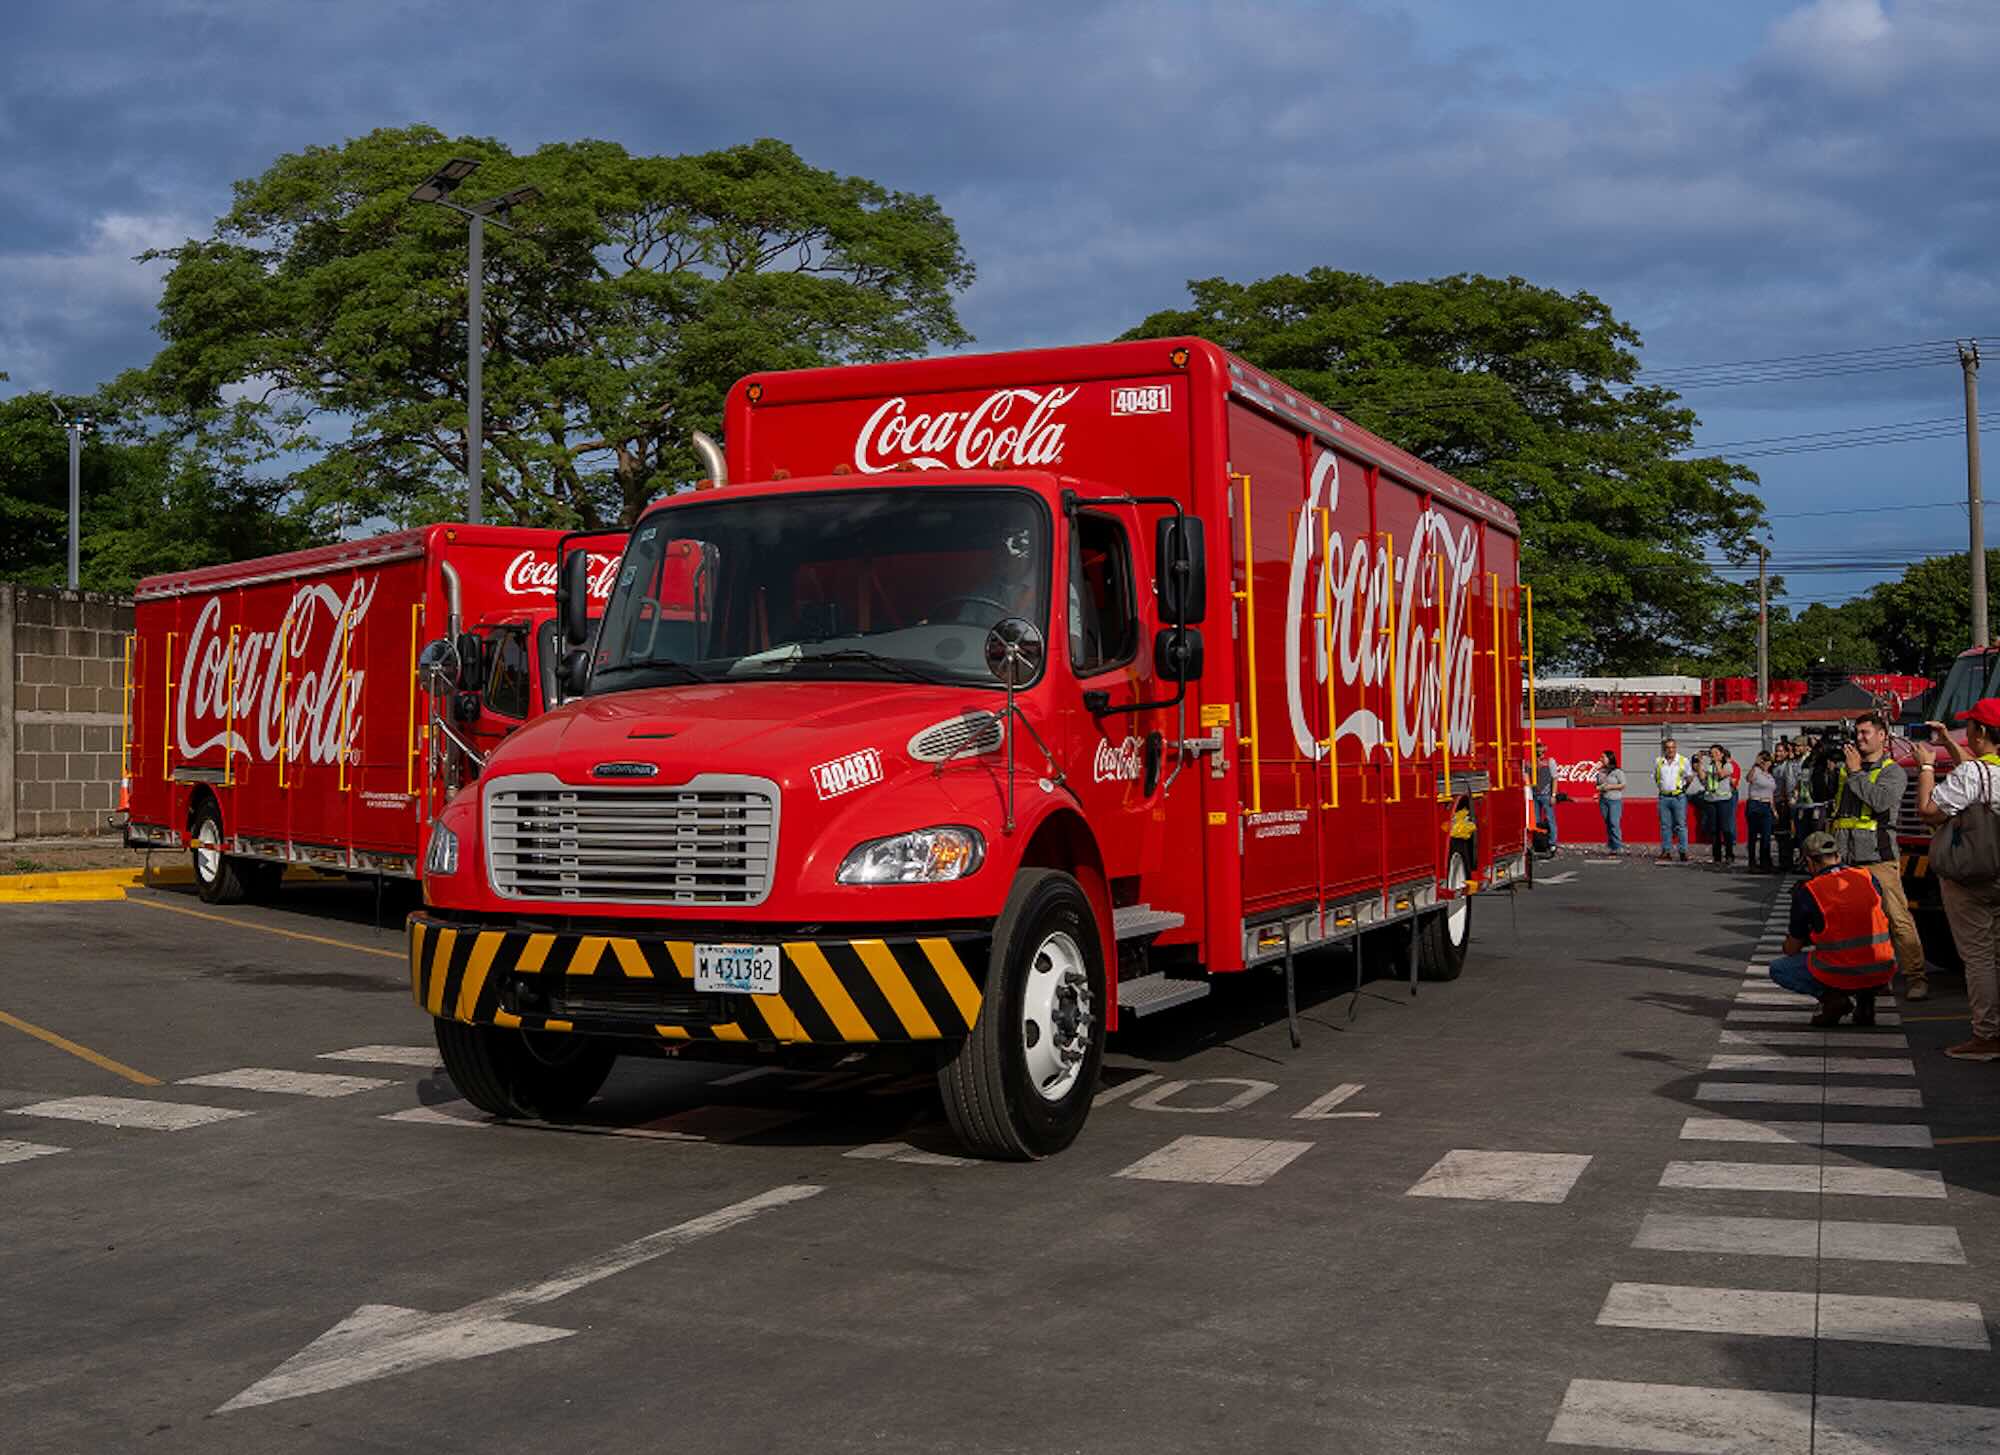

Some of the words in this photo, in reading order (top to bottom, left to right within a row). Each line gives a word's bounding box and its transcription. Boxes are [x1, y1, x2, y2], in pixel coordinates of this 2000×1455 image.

[854, 386, 1081, 475] Coca-Cola
[1116, 388, 1167, 412] 40481
[1285, 450, 1479, 762] Coca-Cola
[177, 571, 380, 765] Coca-Cola
[820, 752, 879, 793] 40481
[699, 958, 709, 979] M
[715, 957, 774, 981] 431382
